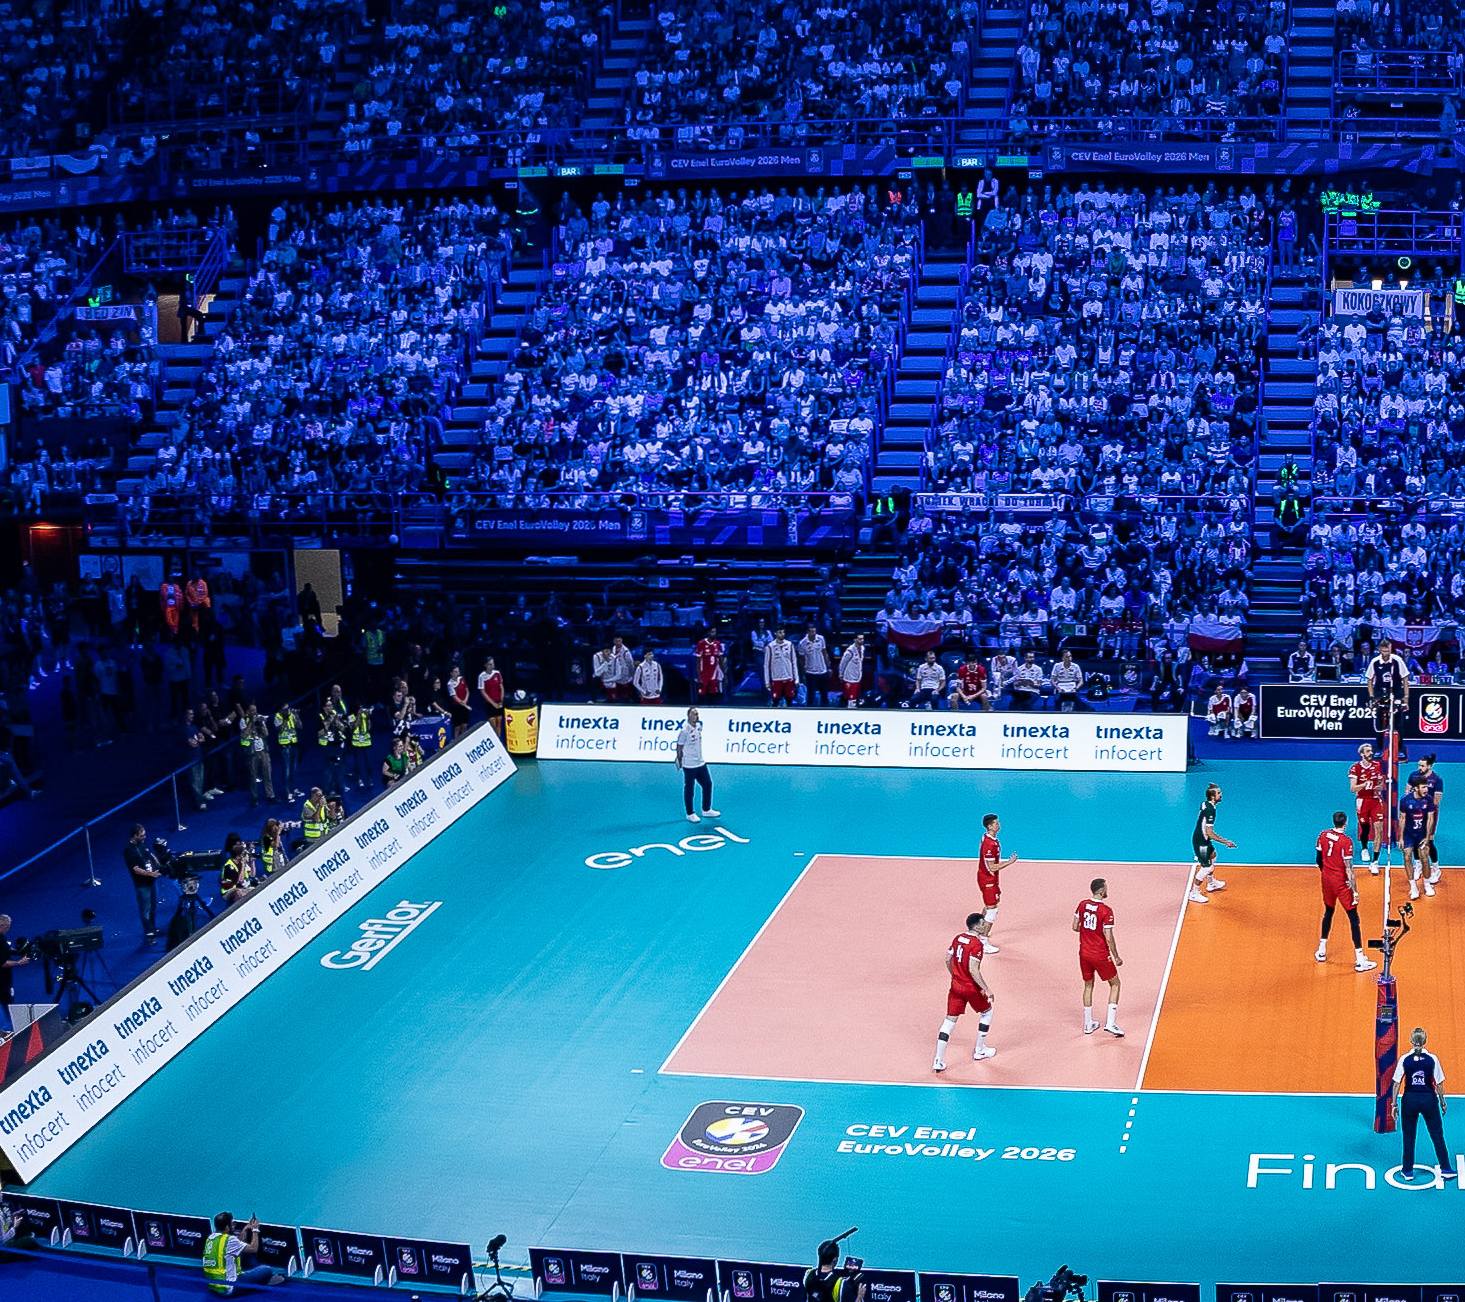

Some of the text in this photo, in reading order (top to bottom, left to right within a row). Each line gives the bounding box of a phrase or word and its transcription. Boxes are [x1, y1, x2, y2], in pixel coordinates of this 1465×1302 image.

[961, 158, 978, 166] BAR
[1071, 152, 1209, 163] CEV Enel EuroVolley 2026 Men
[562, 168, 577, 176] BAR
[475, 520, 494, 530] CEV
[496, 520, 518, 530] Enel
[520, 520, 570, 532] EuroVolley
[598, 520, 620, 530] Men
[1300, 694, 1357, 706] CEV Enel
[1277, 706, 1346, 721] EuroVolley
[558, 715, 1163, 740] tinexta tinexta tinexta
[1314, 719, 1342, 730] Men
[556, 734, 1163, 761] infocert infocert infocert
[585, 827, 750, 869] enel
[219, 917, 265, 957] tinexta
[394, 789, 428, 820] tinexta
[1083, 913, 1098, 930] 30
[320, 899, 431, 970] Gerflor
[13, 808, 440, 1164] infocert infocert infocert
[724, 1104, 775, 1117] CEV
[846, 1124, 976, 1140] CEV Enel
[837, 1140, 1076, 1161] EuroVolley 2026
[677, 1155, 760, 1173] enel
[674, 1278, 694, 1290] Italy
[871, 1291, 891, 1302] Italy
